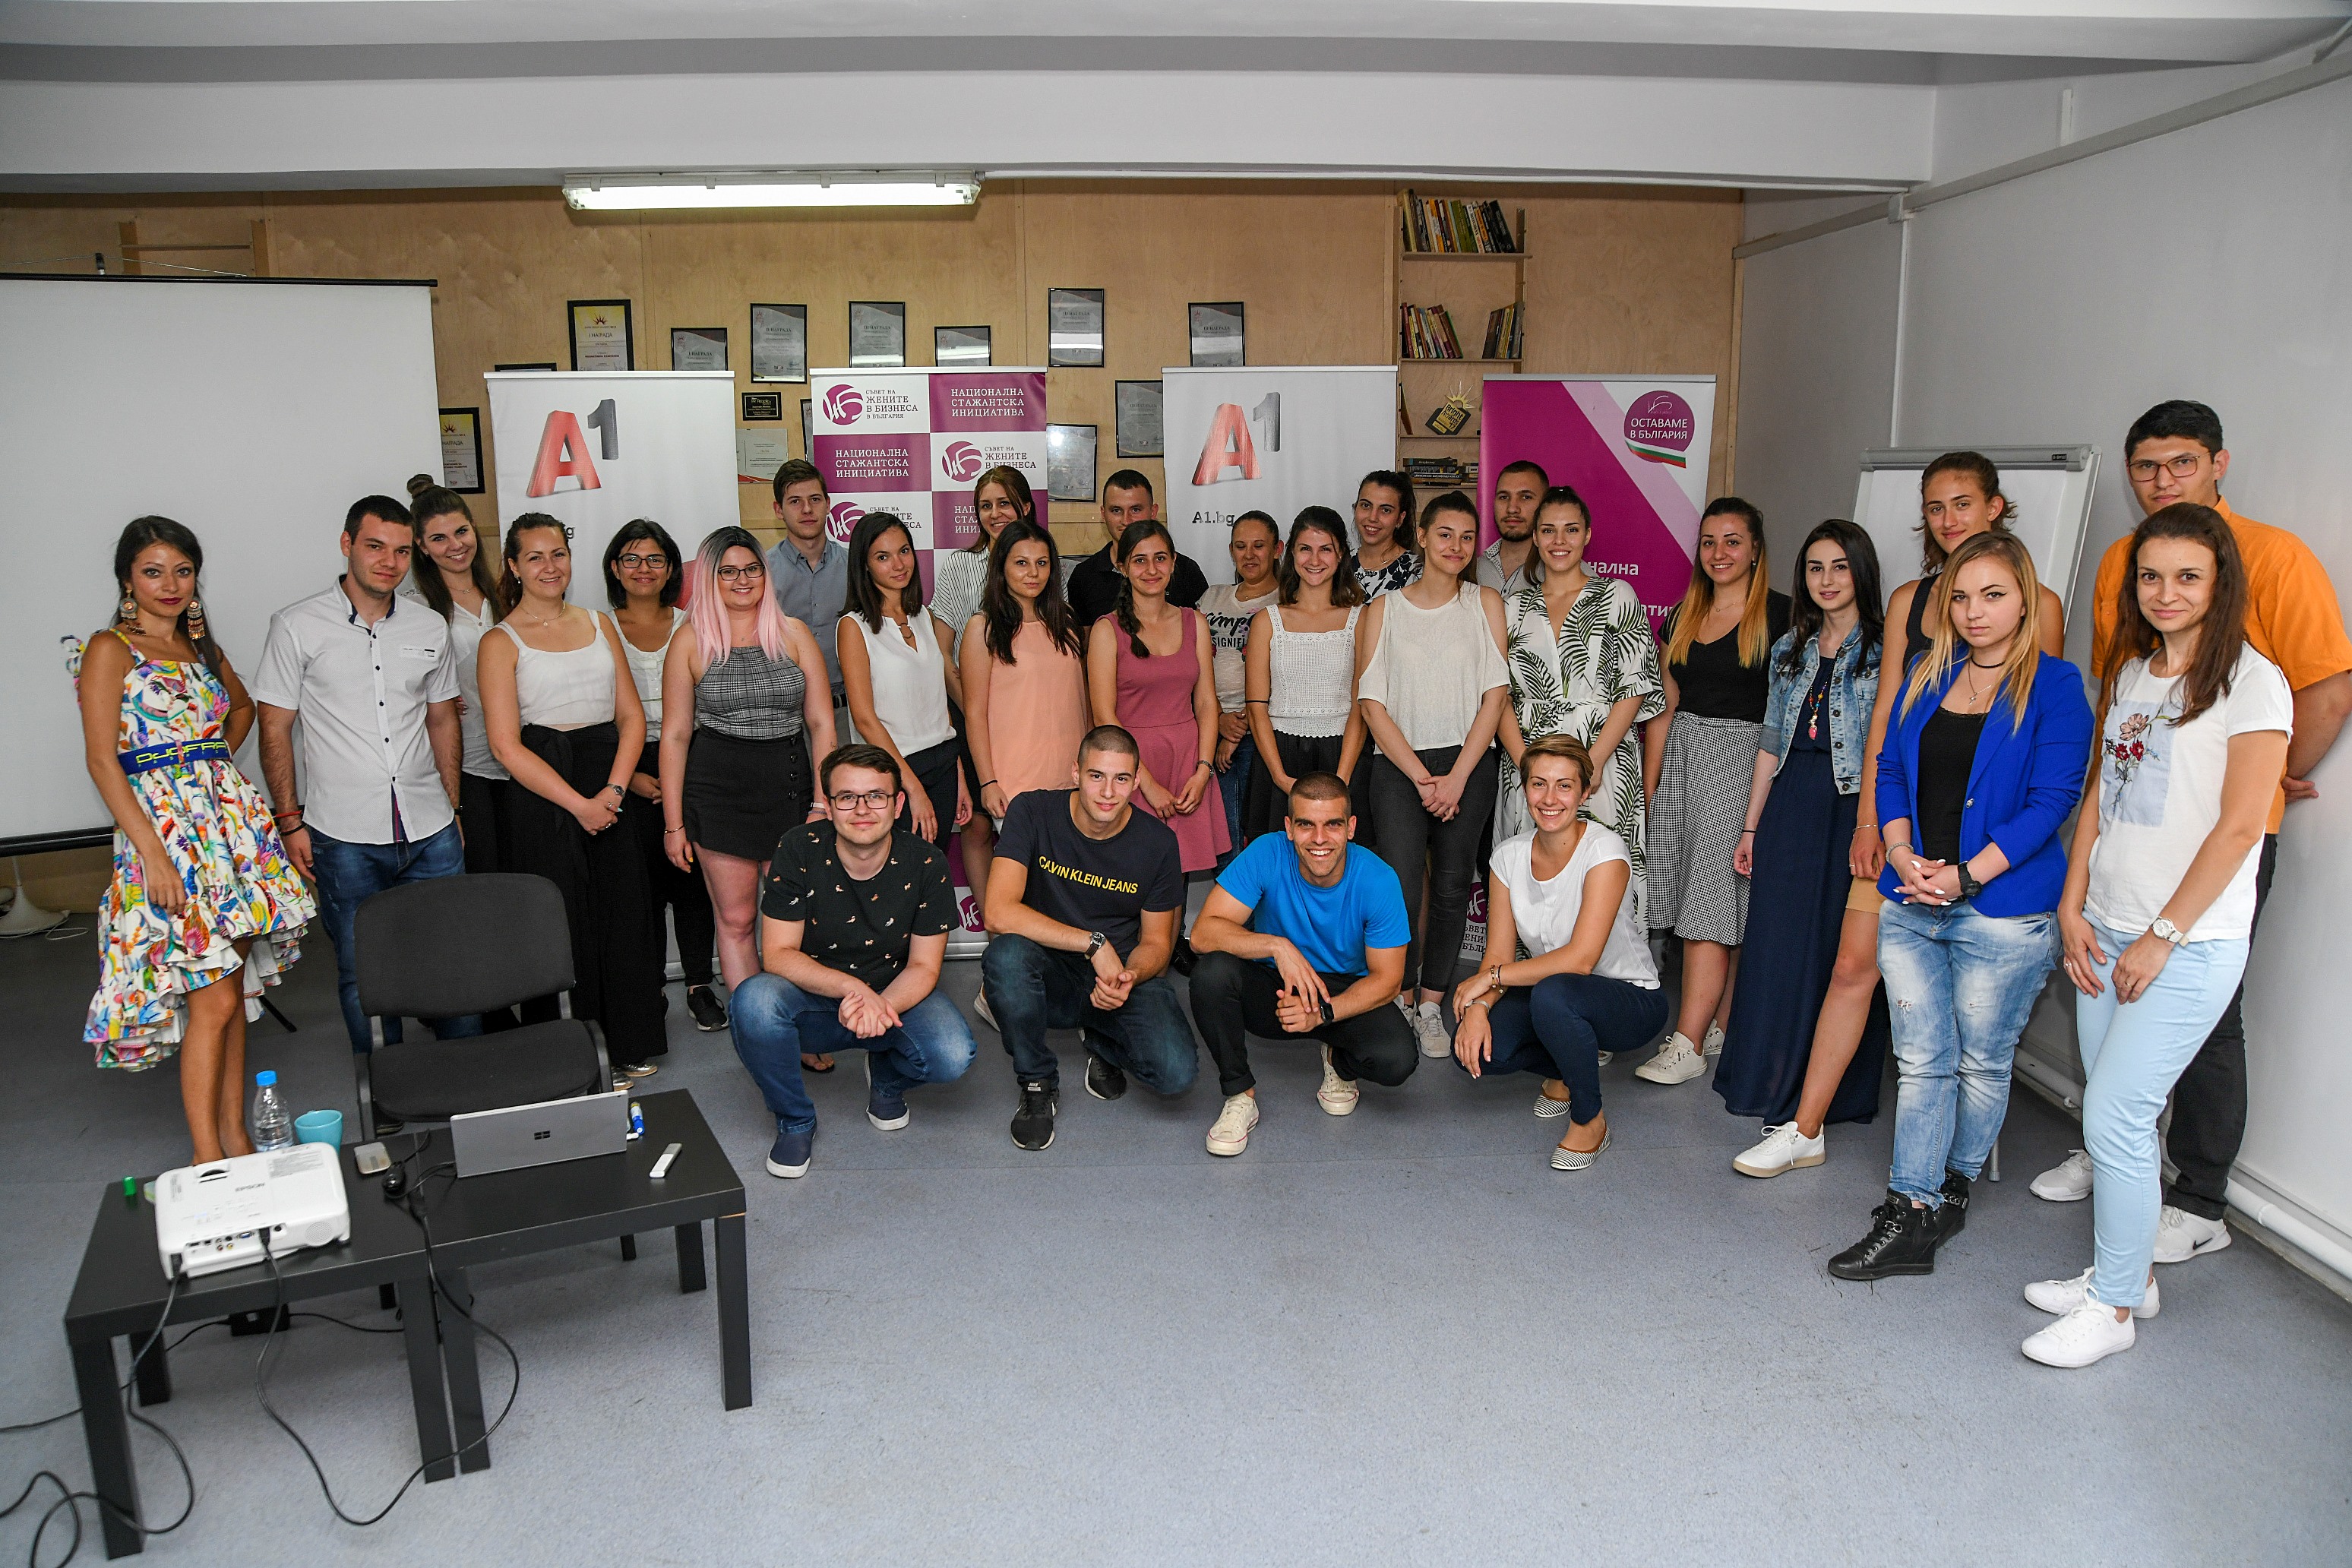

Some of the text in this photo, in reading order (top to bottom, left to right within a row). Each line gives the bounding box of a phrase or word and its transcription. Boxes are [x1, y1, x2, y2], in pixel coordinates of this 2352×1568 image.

[951, 388, 1024, 397] НАЦИОНАЛНА
[951, 398, 1024, 406] СТАЖАНТСКА
[952, 409, 1024, 417] ИНИЦИАТИВА
[1446, 404, 1464, 420] Bright
[1441, 410, 1459, 425] Awards
[1631, 418, 1688, 428] ОСТАВАМЕ
[1191, 392, 1281, 485] A1
[1630, 430, 1687, 439] В БЪЛГАРИЯ
[526, 398, 619, 498] A1
[836, 449, 909, 458] НАЦИОНАЛНА
[836, 459, 909, 467] СТАЖАНТСКА
[836, 469, 909, 478] ИНИЦИАТИВА
[1192, 511, 1235, 526] A1.bg
[1588, 561, 1639, 576] нална
[1212, 637, 1246, 648] SIGNIFI
[1038, 855, 1138, 894] CALVIN KLEIN JEANS
